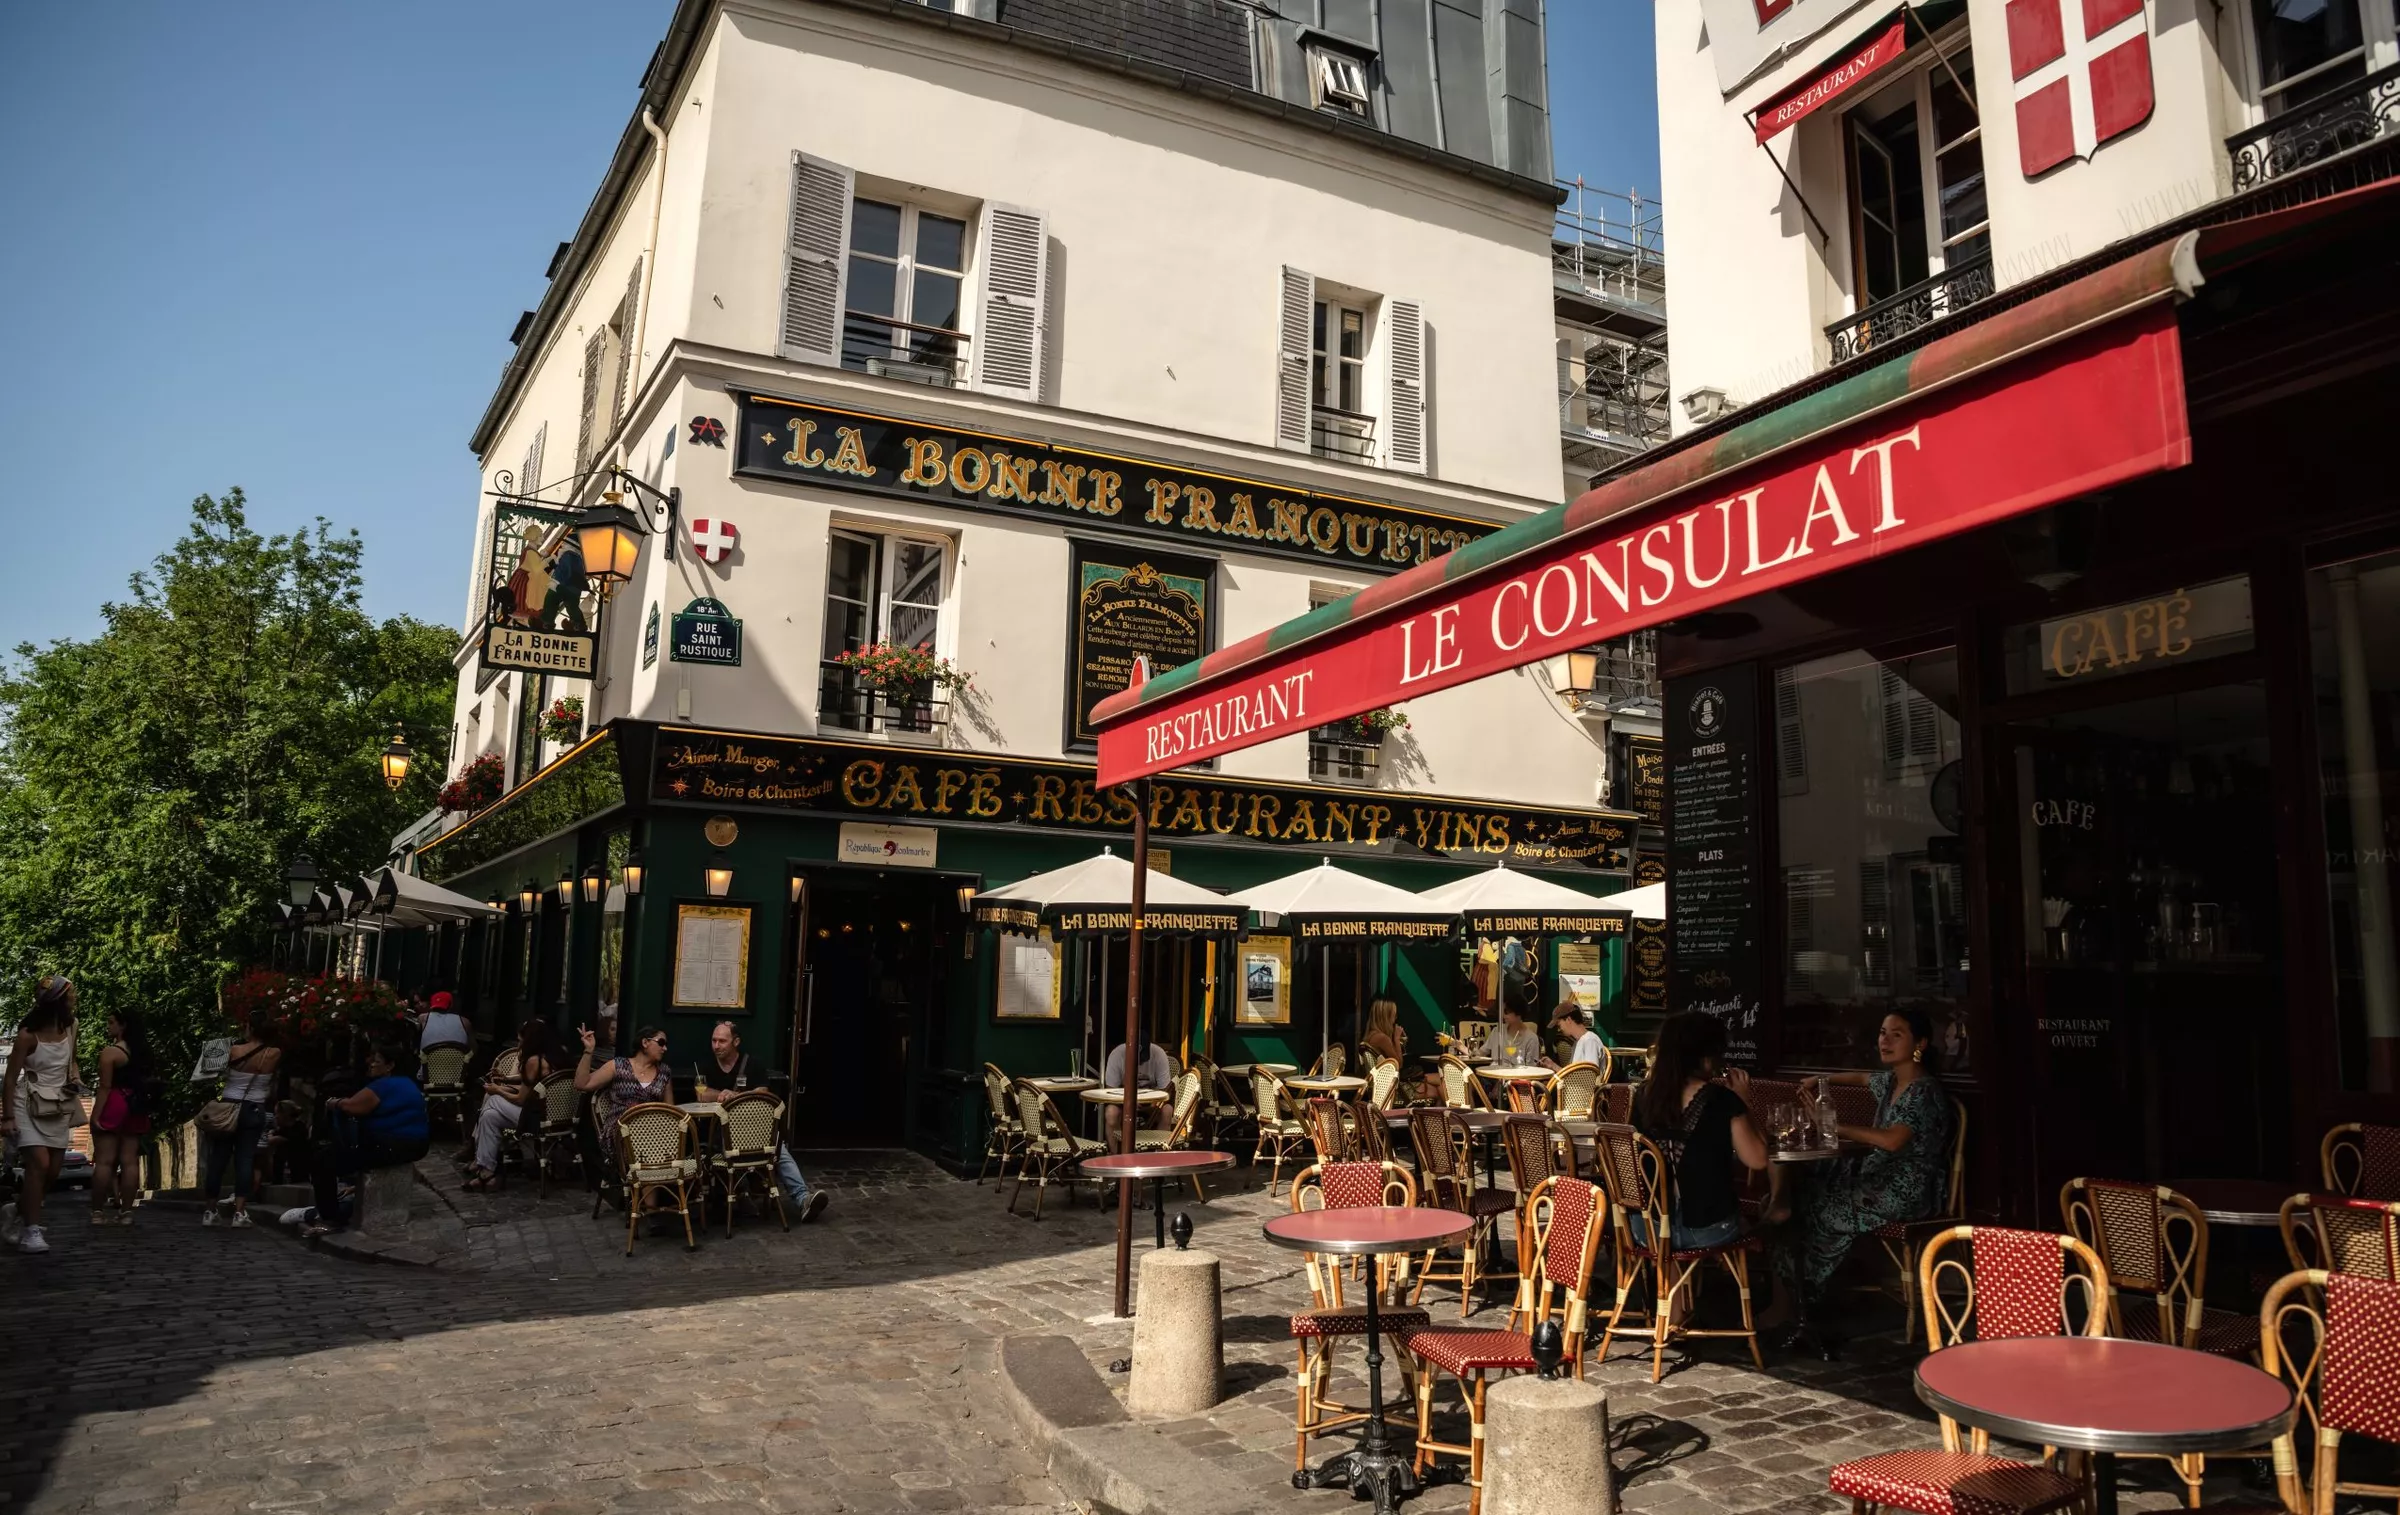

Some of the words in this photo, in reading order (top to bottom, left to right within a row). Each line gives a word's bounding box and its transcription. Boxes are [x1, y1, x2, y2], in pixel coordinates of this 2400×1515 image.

[1776, 45, 1879, 123] RESTAURANT
[783, 418, 877, 477] LA
[900, 437, 1123, 516] BONNE
[1144, 478, 1484, 566] FRANQUET
[1400, 603, 1464, 685] LE
[1491, 425, 1922, 651] CONSULAT
[1138, 599, 1196, 637] FRANQUETTE
[696, 623, 718, 634] RUE
[2052, 588, 2192, 677] CAFÉ
[504, 632, 523, 647] LA
[531, 634, 579, 653] BONNE
[691, 634, 722, 646] SAINT
[493, 644, 587, 669] FRANQUETTE
[680, 645, 732, 658] RUSTIQUE
[1146, 669, 1313, 763] RESTAURANT
[1692, 742, 1726, 757] ENTRÉES
[702, 777, 744, 799] Boire
[748, 785, 764, 799] et
[841, 759, 1003, 817] CAFÉ
[1028, 774, 1392, 846] RESTAURANT
[1412, 808, 1511, 854] VINS
[2032, 799, 2096, 830] CAFÉ
[1514, 841, 1543, 858] Boire
[1544, 847, 1557, 859] et
[1698, 850, 1724, 862] PLATS
[1061, 914, 1083, 930] LA
[1087, 913, 1132, 929] BONN
[1143, 913, 1238, 931] FRANQUETTE
[1302, 922, 1320, 936] LA
[1323, 921, 1367, 936] BONNE
[1370, 921, 1449, 938] FRANQUETTE
[1474, 917, 1493, 931] LA
[1496, 917, 1539, 931] BONNE
[1542, 917, 1624, 933] FRANQUETTE
[2037, 1017, 2112, 1032] RESTAURANT
[2051, 1034, 2099, 1048] OUVERT
